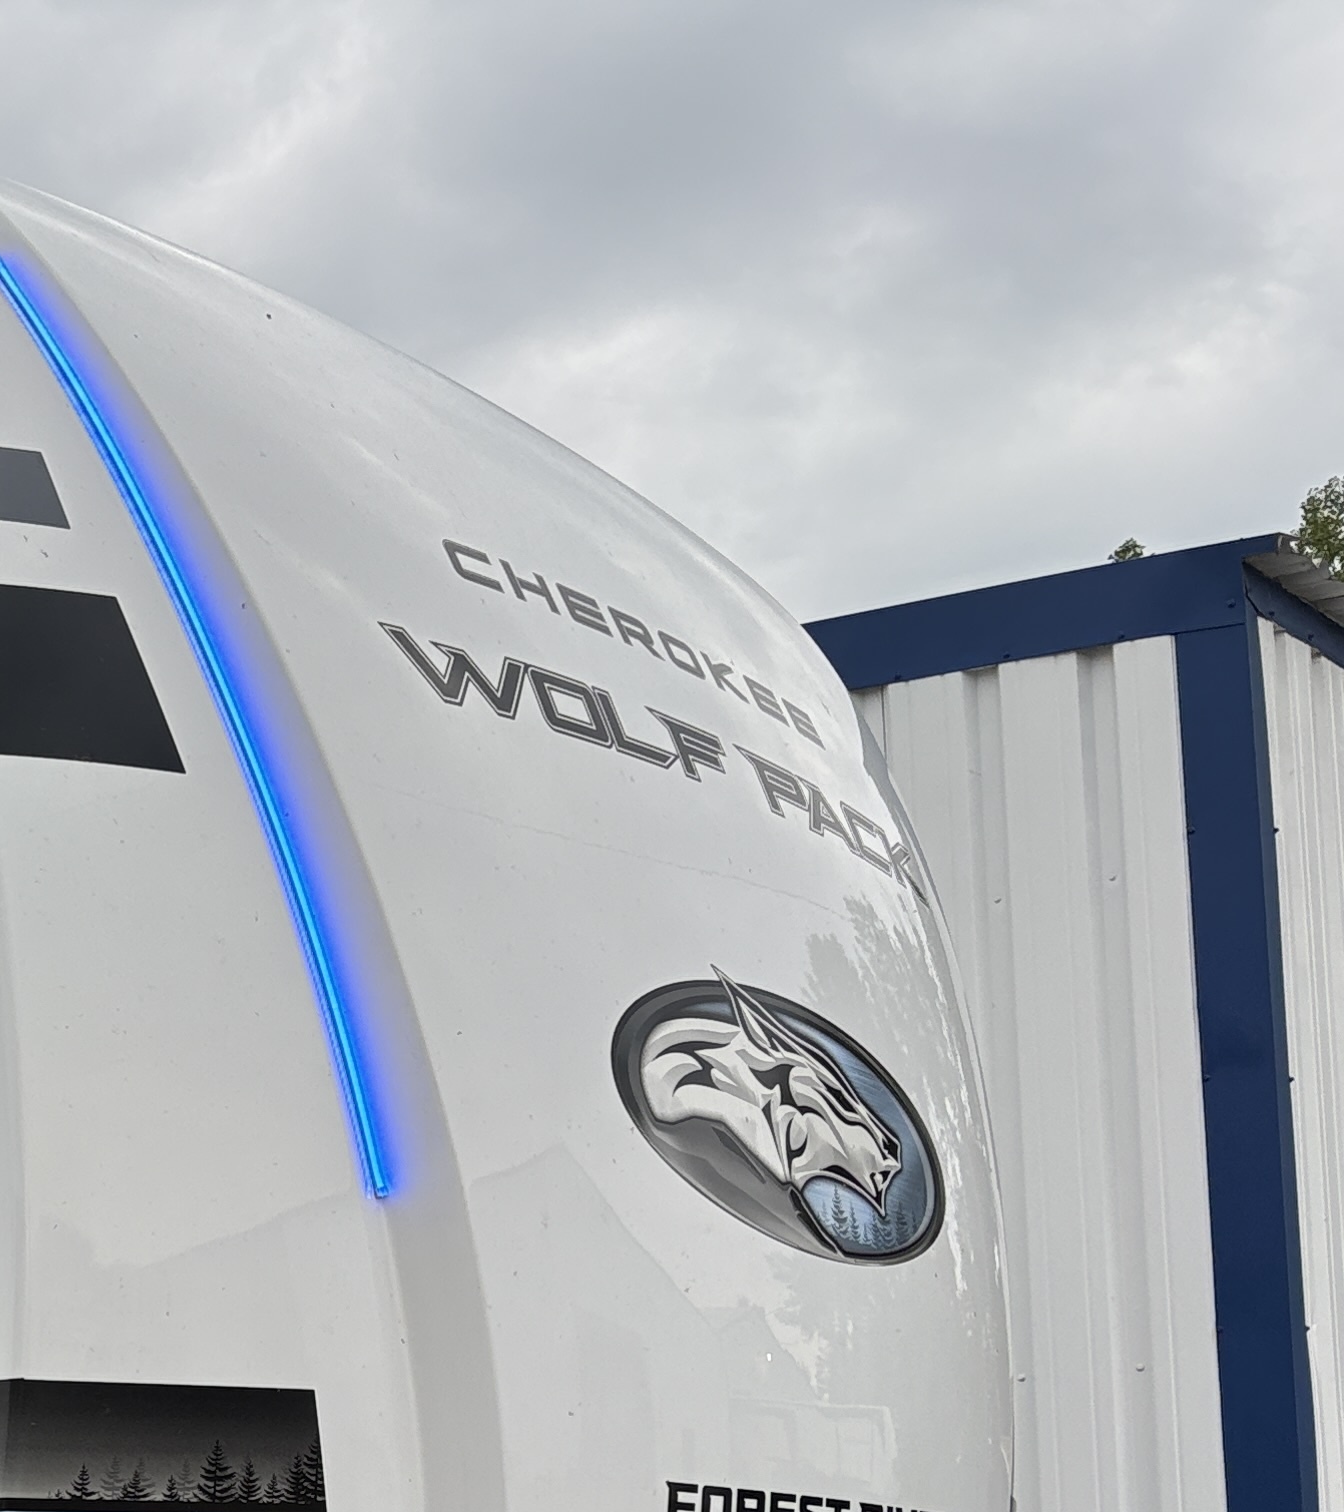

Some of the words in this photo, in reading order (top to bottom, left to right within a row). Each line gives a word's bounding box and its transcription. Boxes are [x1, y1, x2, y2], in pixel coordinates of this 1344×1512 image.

[377, 620, 728, 782] WOLF
[733, 744, 930, 908] PACK
[442, 537, 826, 750] CHEROKEE
